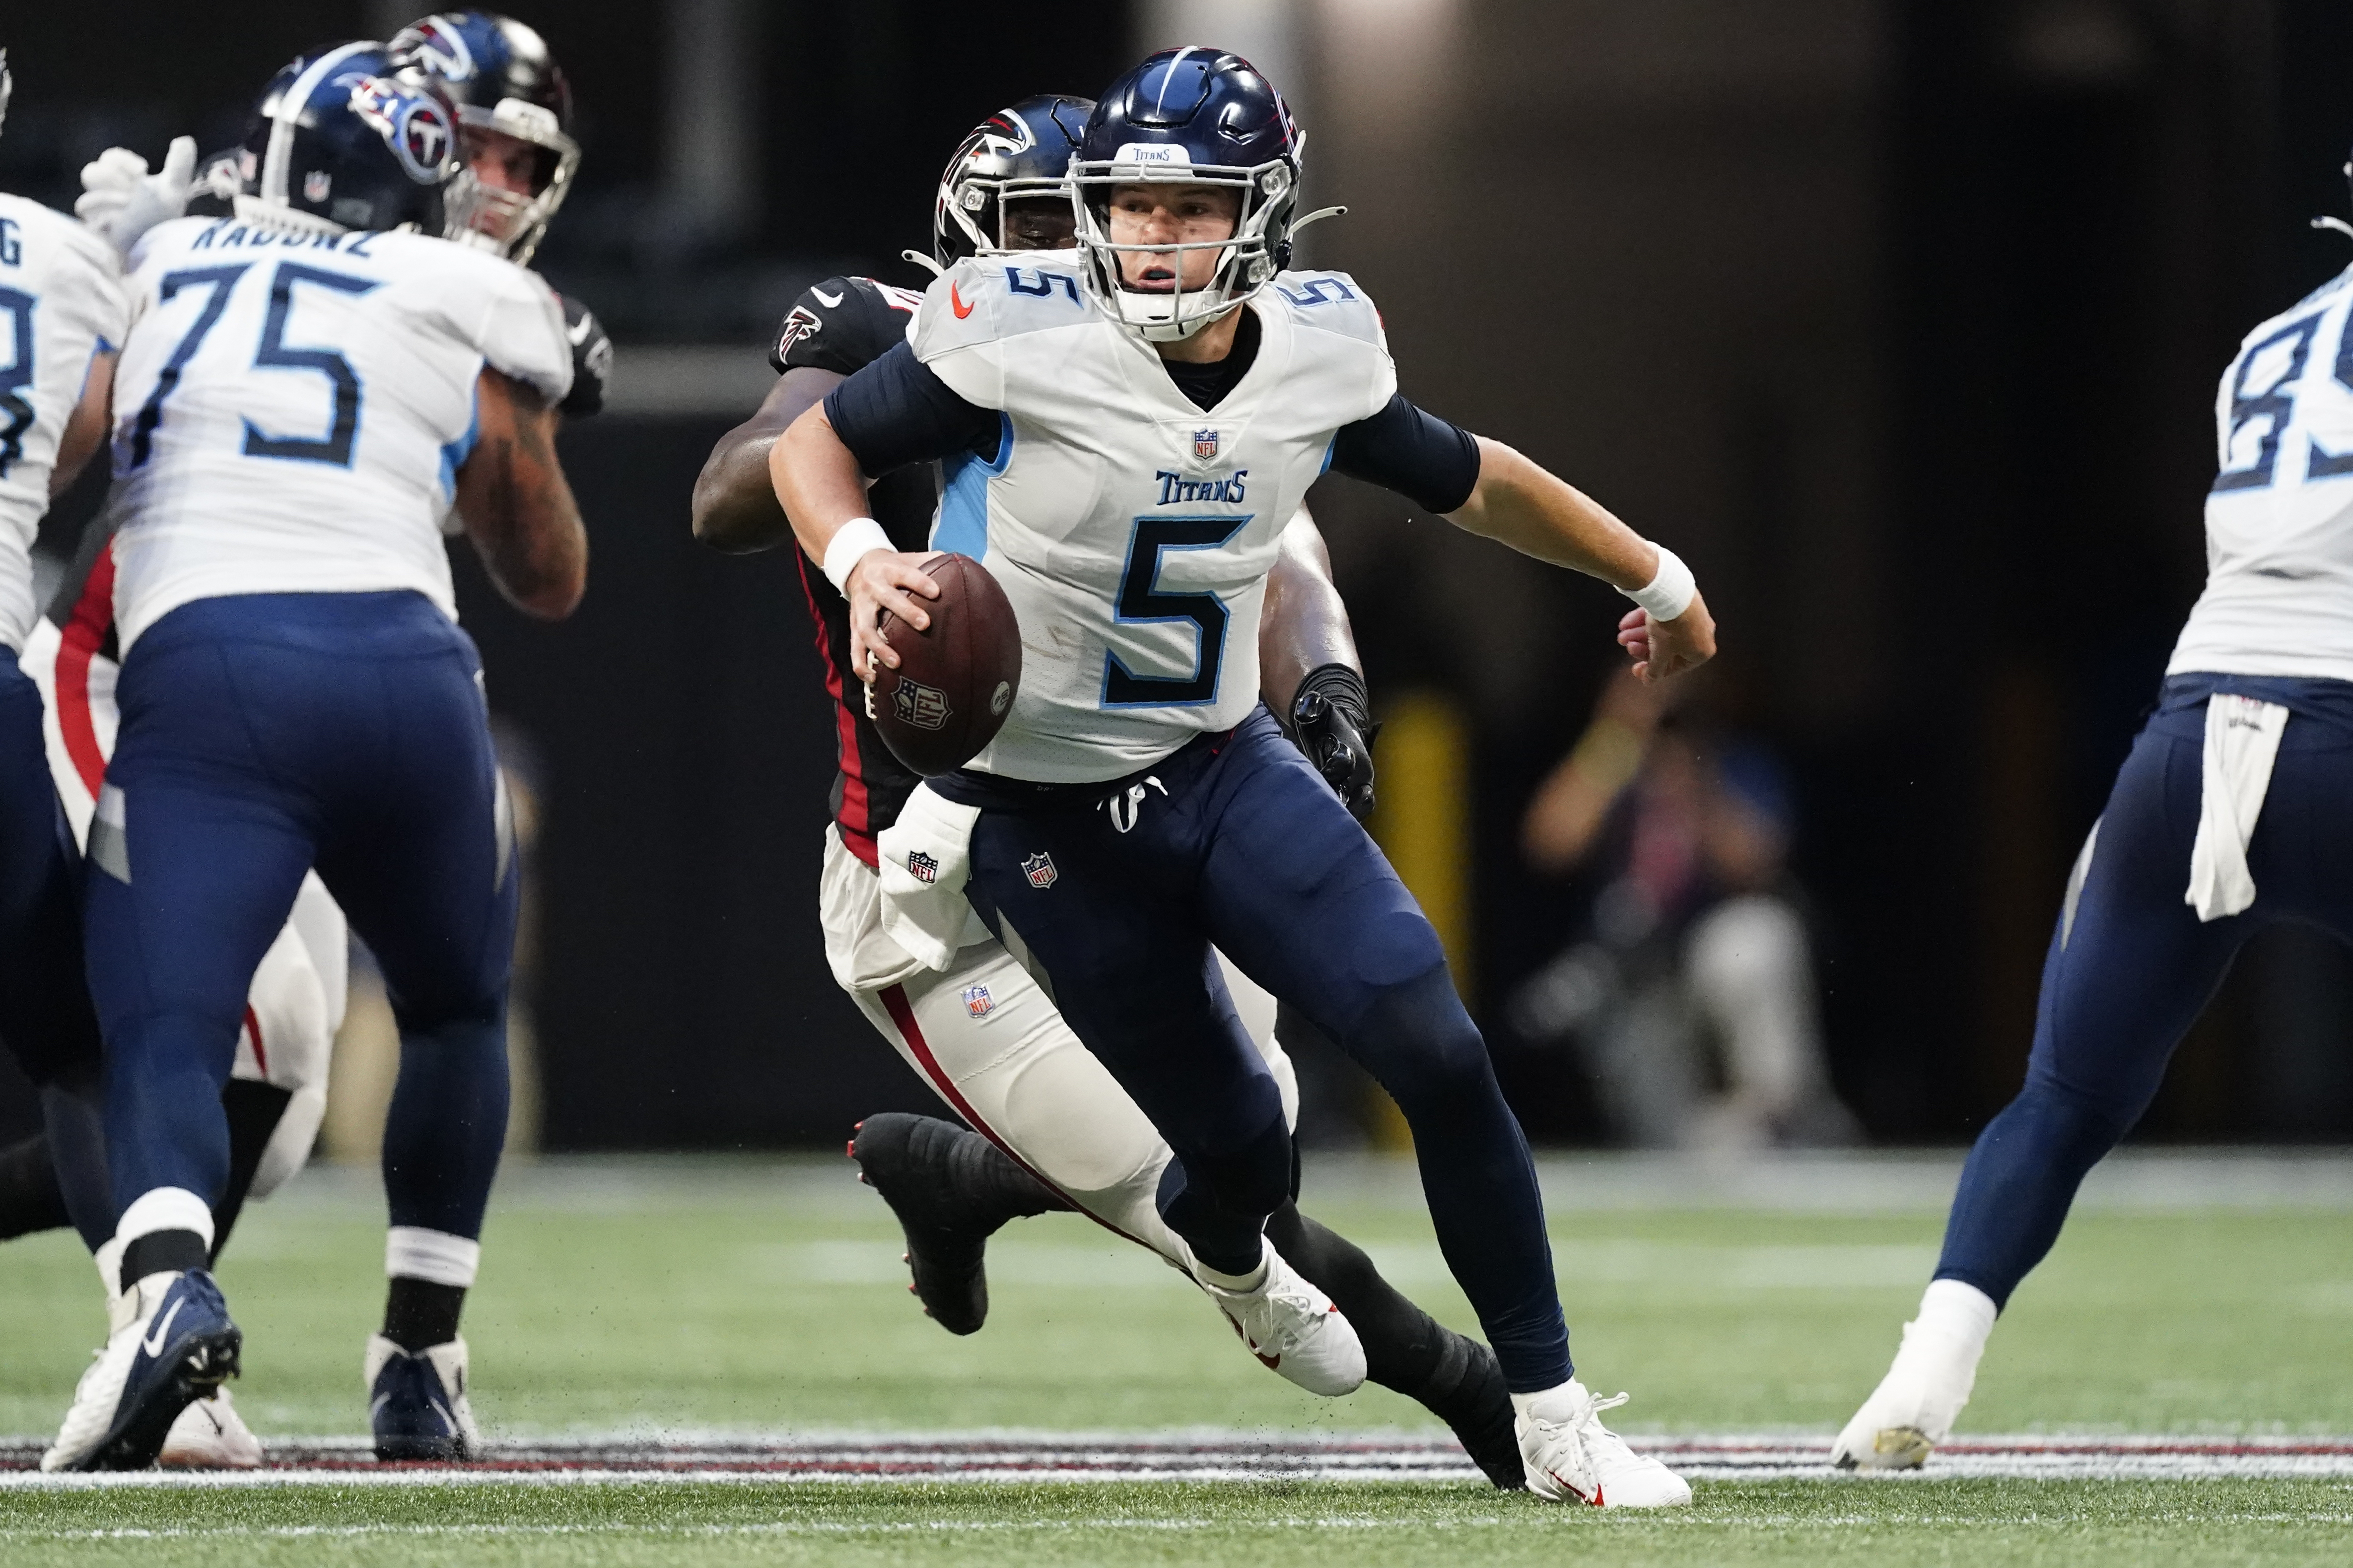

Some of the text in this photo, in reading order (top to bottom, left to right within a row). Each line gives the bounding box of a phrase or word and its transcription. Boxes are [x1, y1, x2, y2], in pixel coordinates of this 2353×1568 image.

[1002, 265, 1084, 310] 5
[1274, 277, 1359, 309] 5
[130, 259, 391, 472] 75
[1196, 442, 1215, 456] NFL
[1099, 514, 1255, 710] 5
[915, 692, 945, 725] NFL
[911, 862, 933, 882] NFL
[1032, 868, 1053, 884] NFL
[969, 998, 990, 1013] NFL
